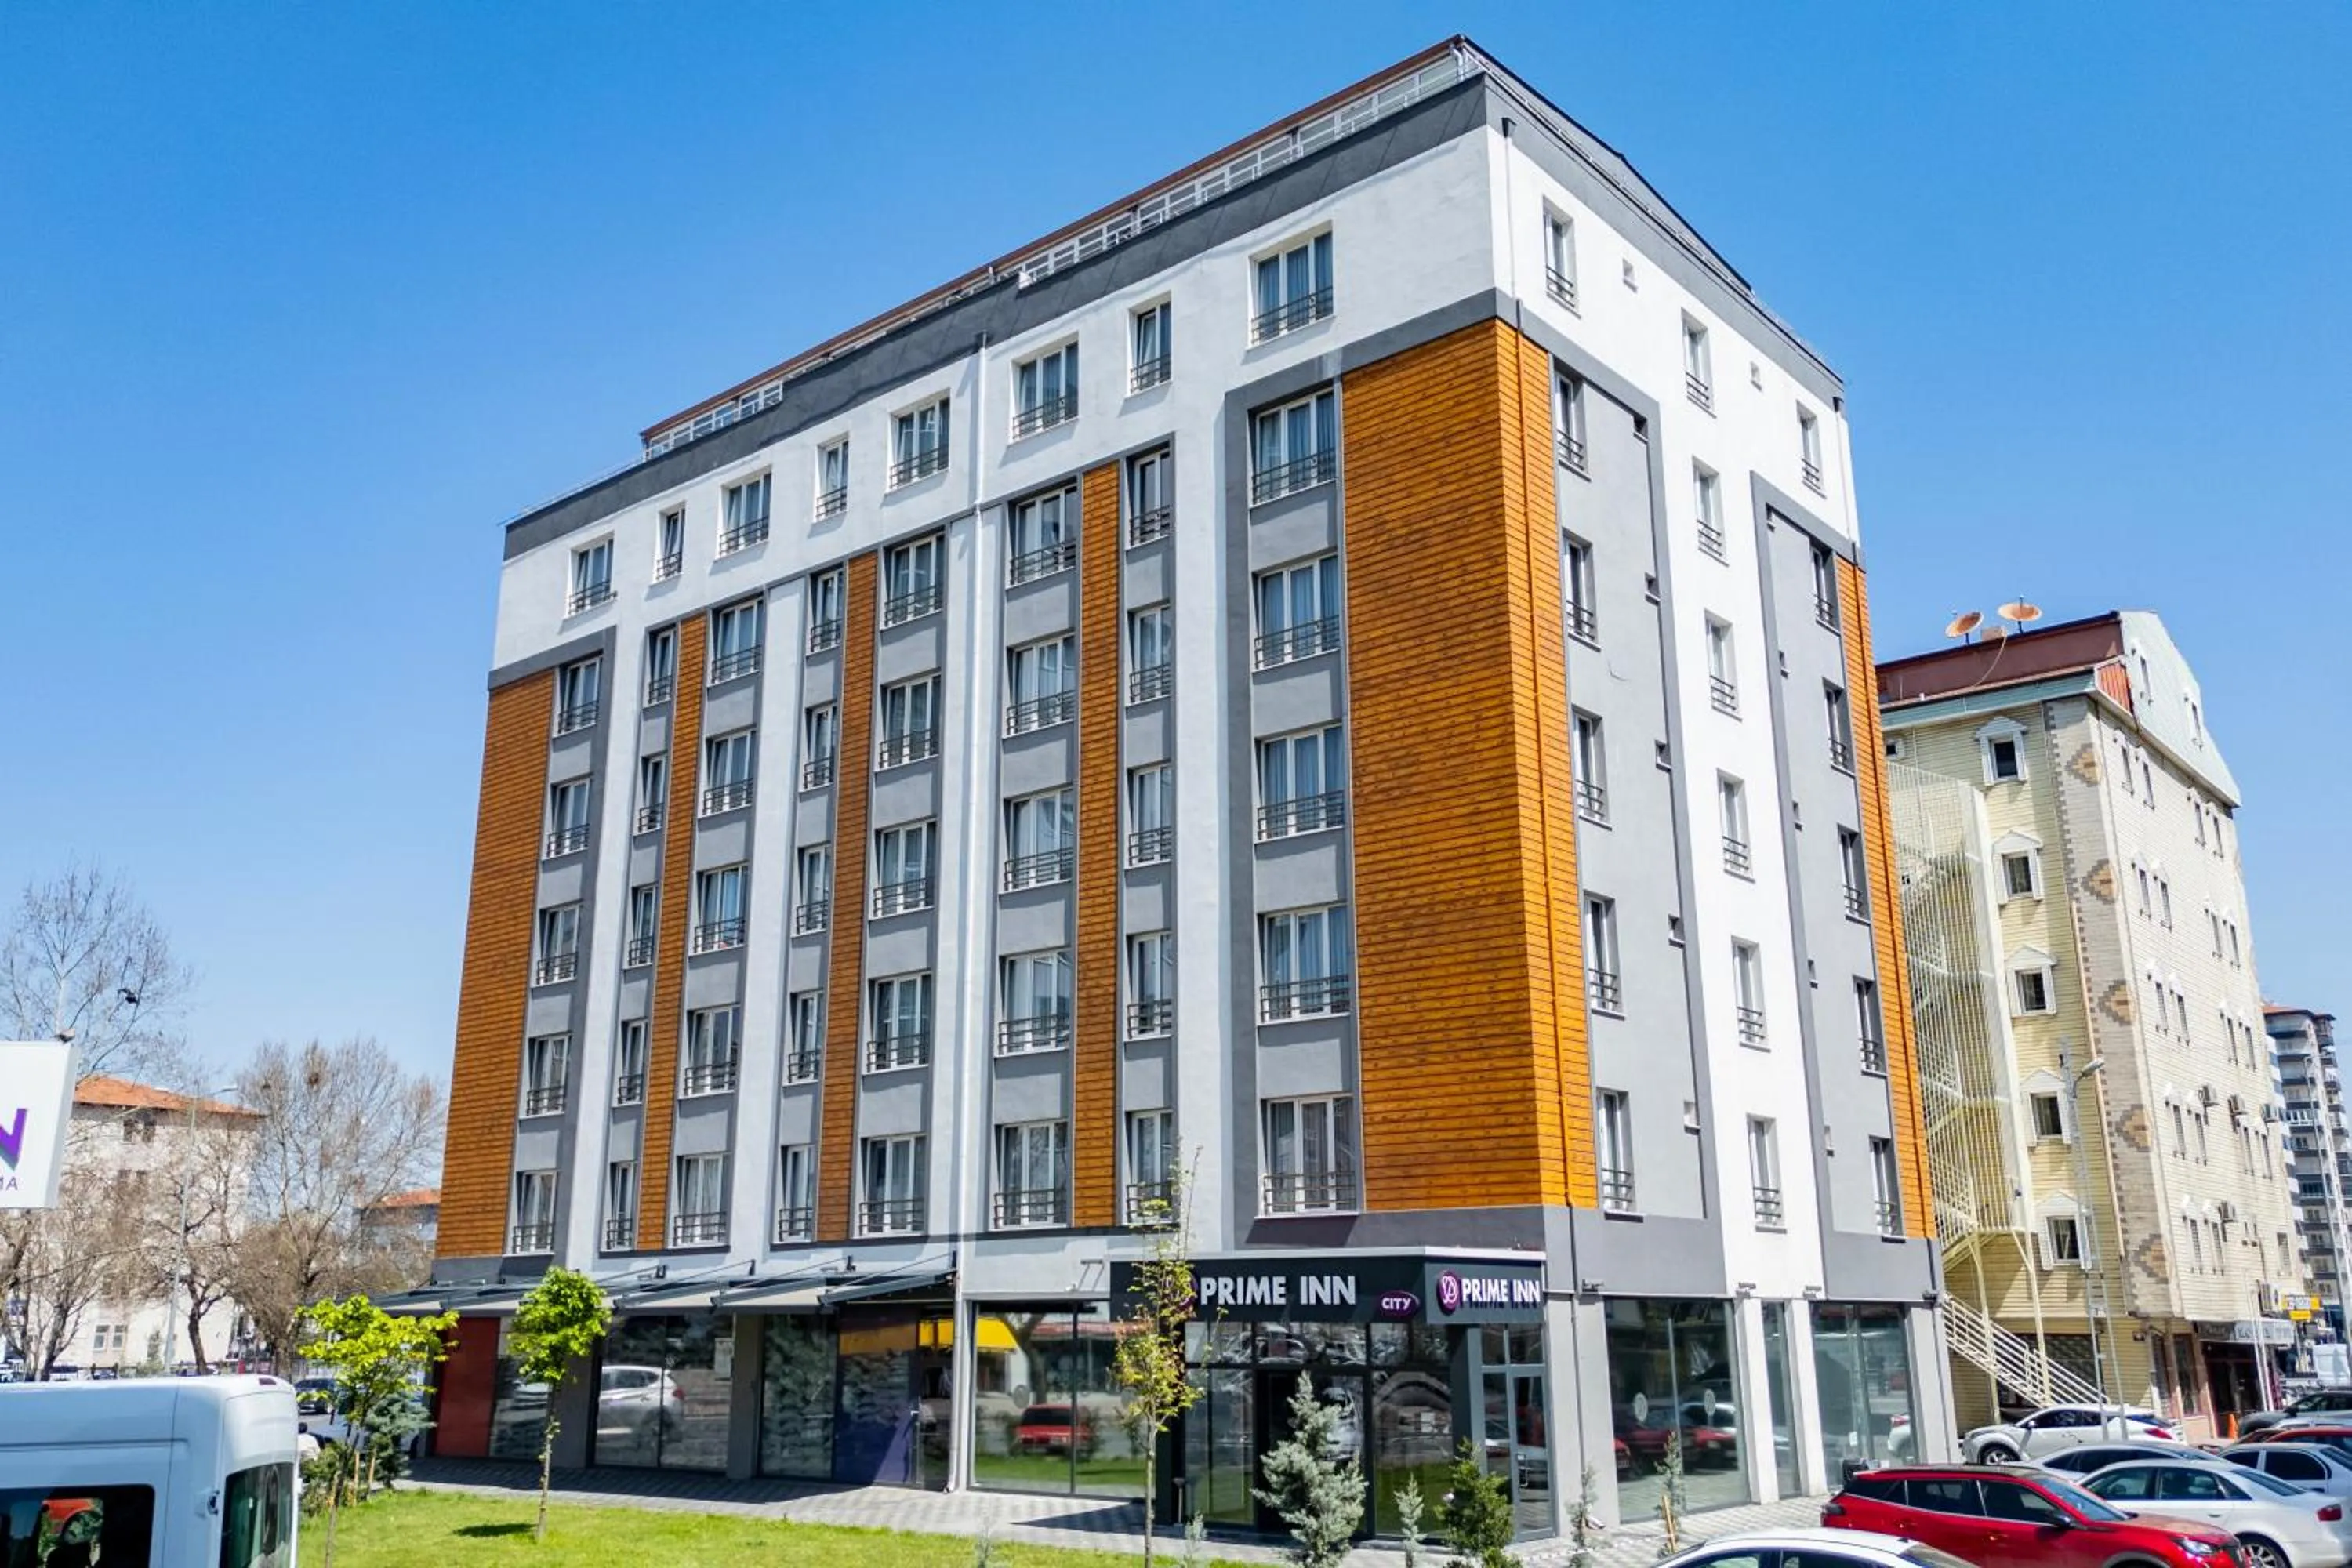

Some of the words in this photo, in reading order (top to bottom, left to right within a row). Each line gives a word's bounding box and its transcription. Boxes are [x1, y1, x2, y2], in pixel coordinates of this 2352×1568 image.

[1200, 1276, 1287, 1305] PRIME
[1300, 1275, 1356, 1305] INN
[1461, 1278, 1510, 1303] PRIME
[1512, 1279, 1541, 1303] INN
[1381, 1298, 1413, 1310] CITY
